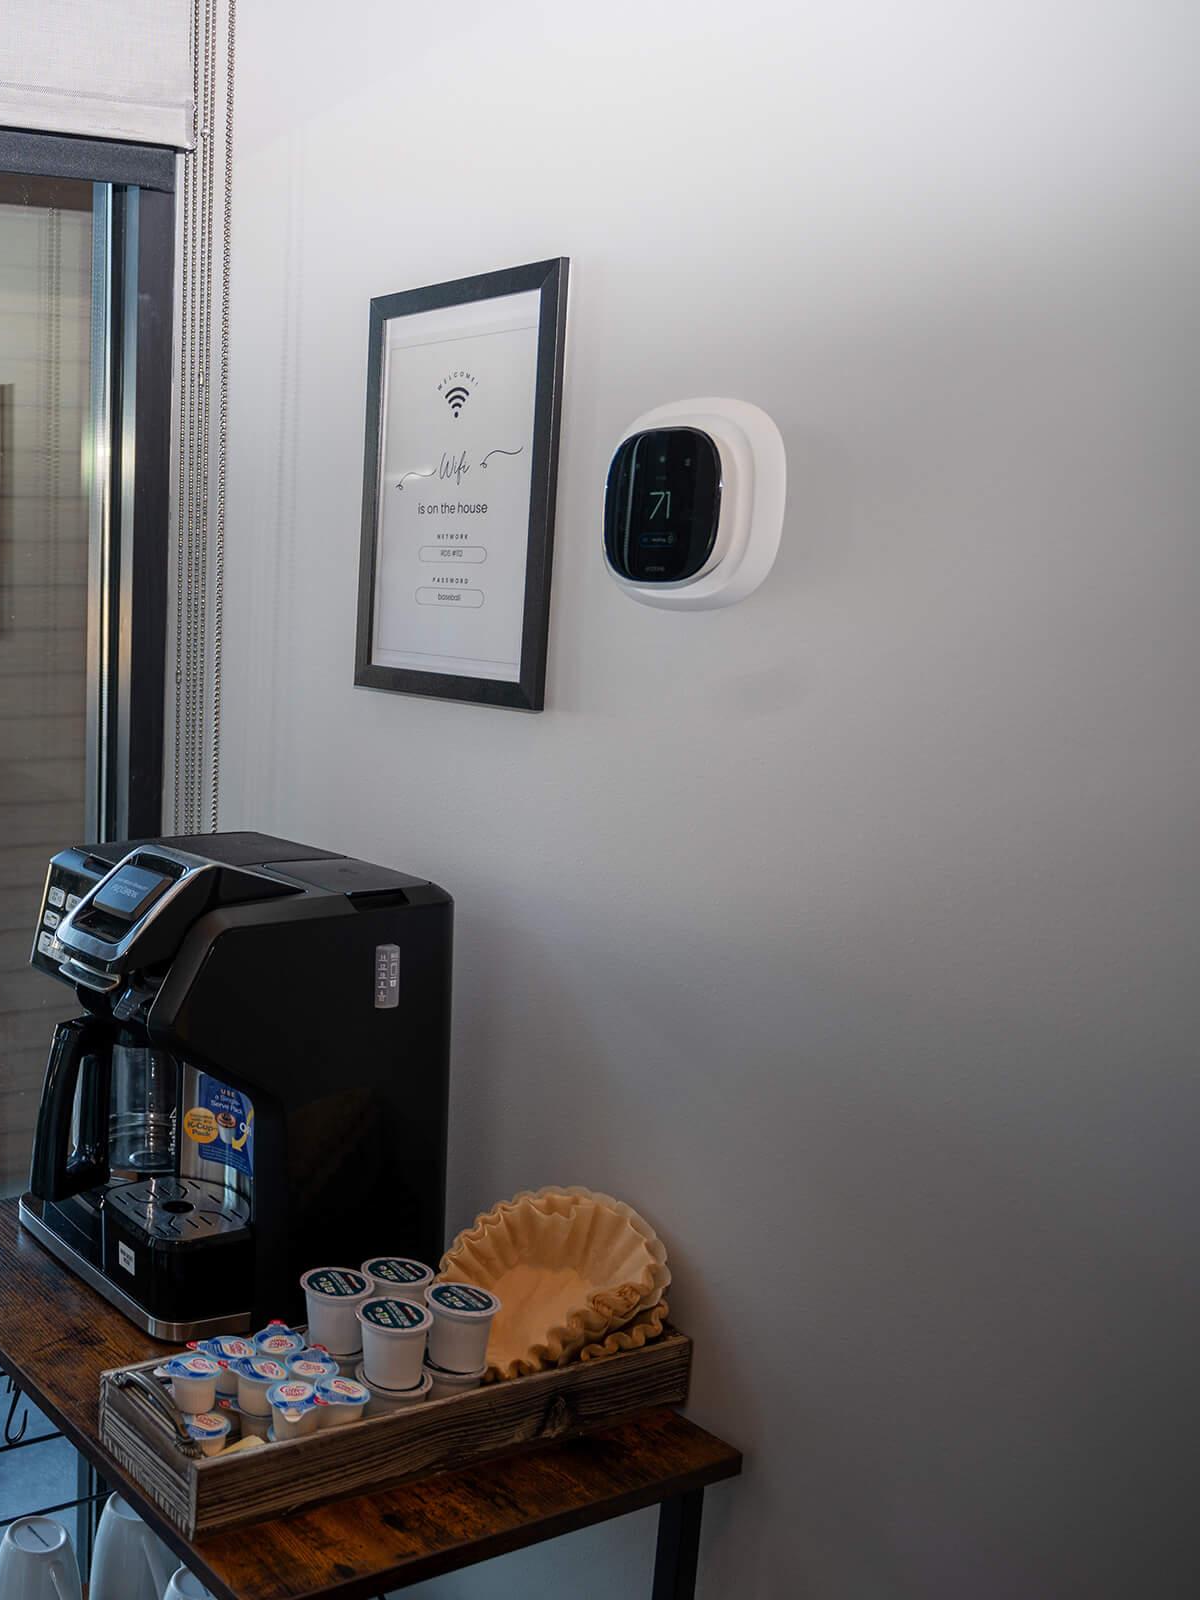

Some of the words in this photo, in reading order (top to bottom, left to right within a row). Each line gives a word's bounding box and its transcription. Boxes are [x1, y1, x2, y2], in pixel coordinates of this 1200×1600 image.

[440, 450, 471, 485] Wifi
[417, 502, 426, 515] is
[427, 504, 439, 515] on
[440, 502, 456, 514] the
[457, 502, 488, 514] house
[649, 490, 673, 520] 71
[432, 577, 468, 585] PASSWORD
